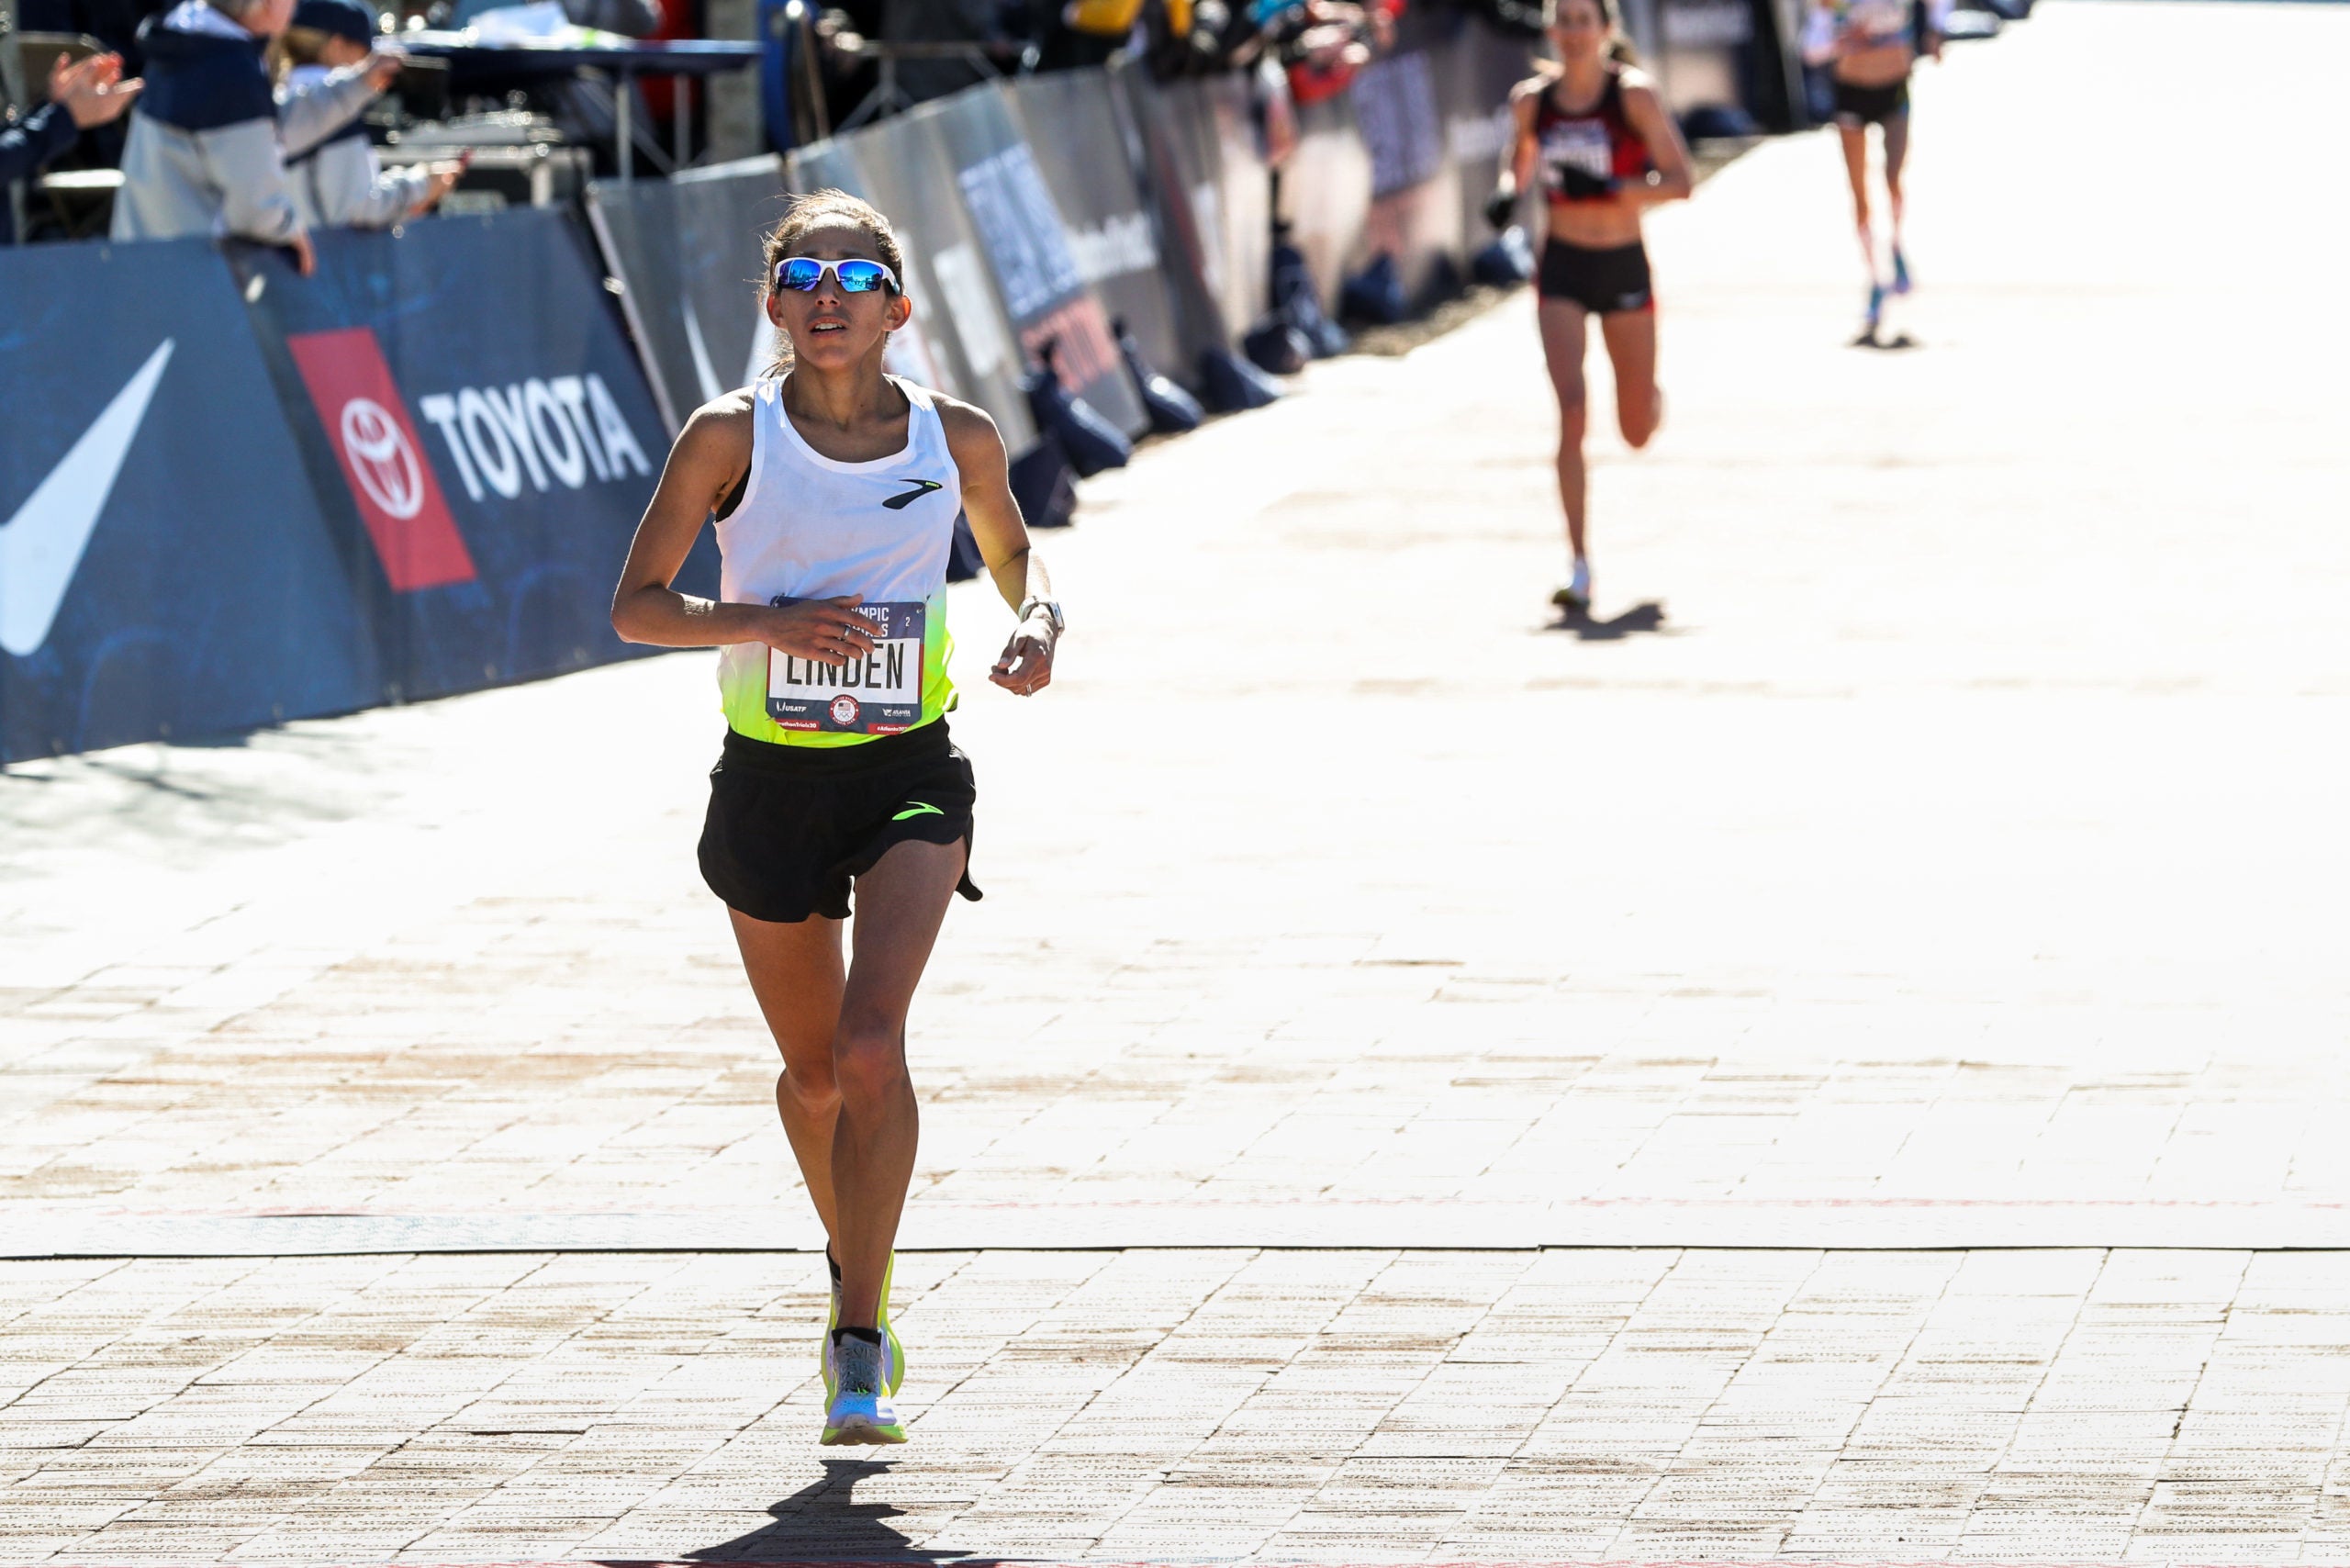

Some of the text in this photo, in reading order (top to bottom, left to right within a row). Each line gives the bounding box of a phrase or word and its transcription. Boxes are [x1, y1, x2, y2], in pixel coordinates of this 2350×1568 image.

[419, 373, 653, 503] TOYOTA
[851, 607, 890, 622] MPIC
[905, 616, 911, 627] 2
[787, 643, 904, 689] LINDEN
